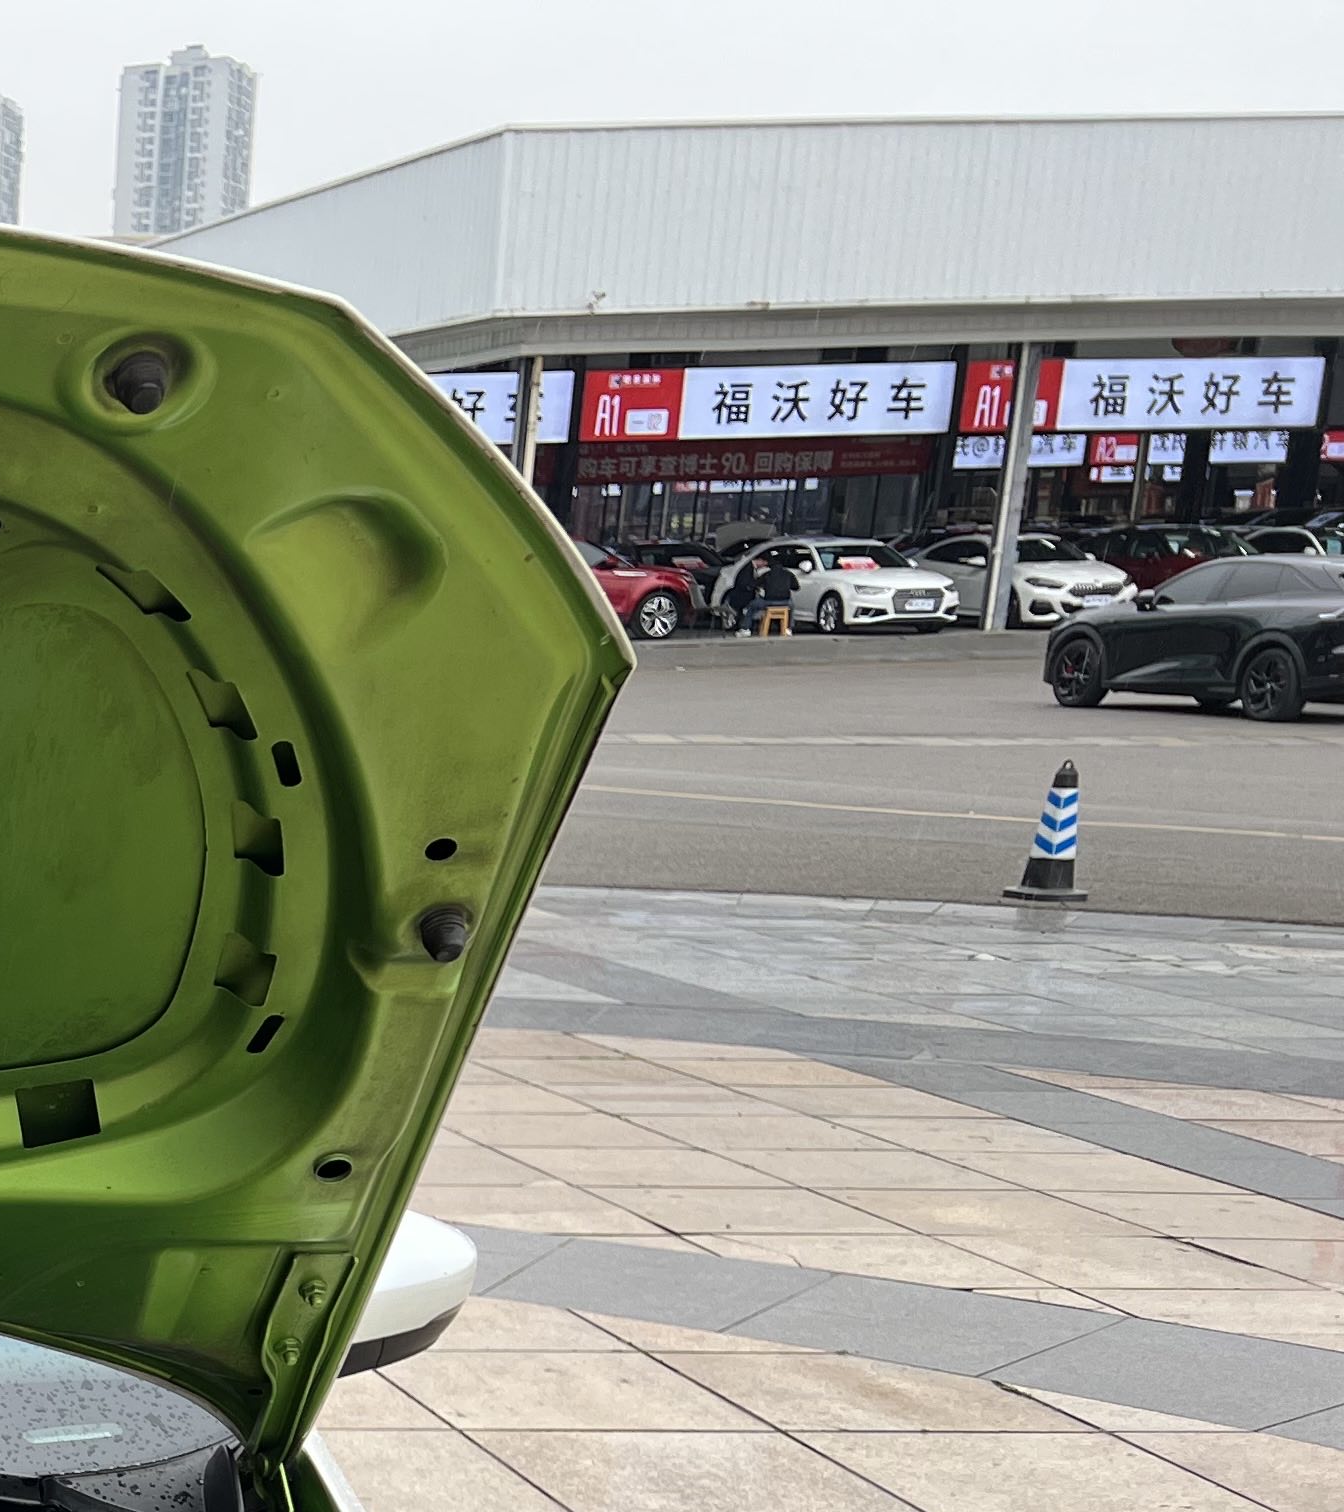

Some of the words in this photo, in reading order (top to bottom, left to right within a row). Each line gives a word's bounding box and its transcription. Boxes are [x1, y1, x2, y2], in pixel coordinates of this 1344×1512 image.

[594, 394, 621, 437] A1
[712, 376, 927, 425] 福沃好车
[973, 384, 1002, 429] A1
[1089, 371, 1296, 417] 福沃好车
